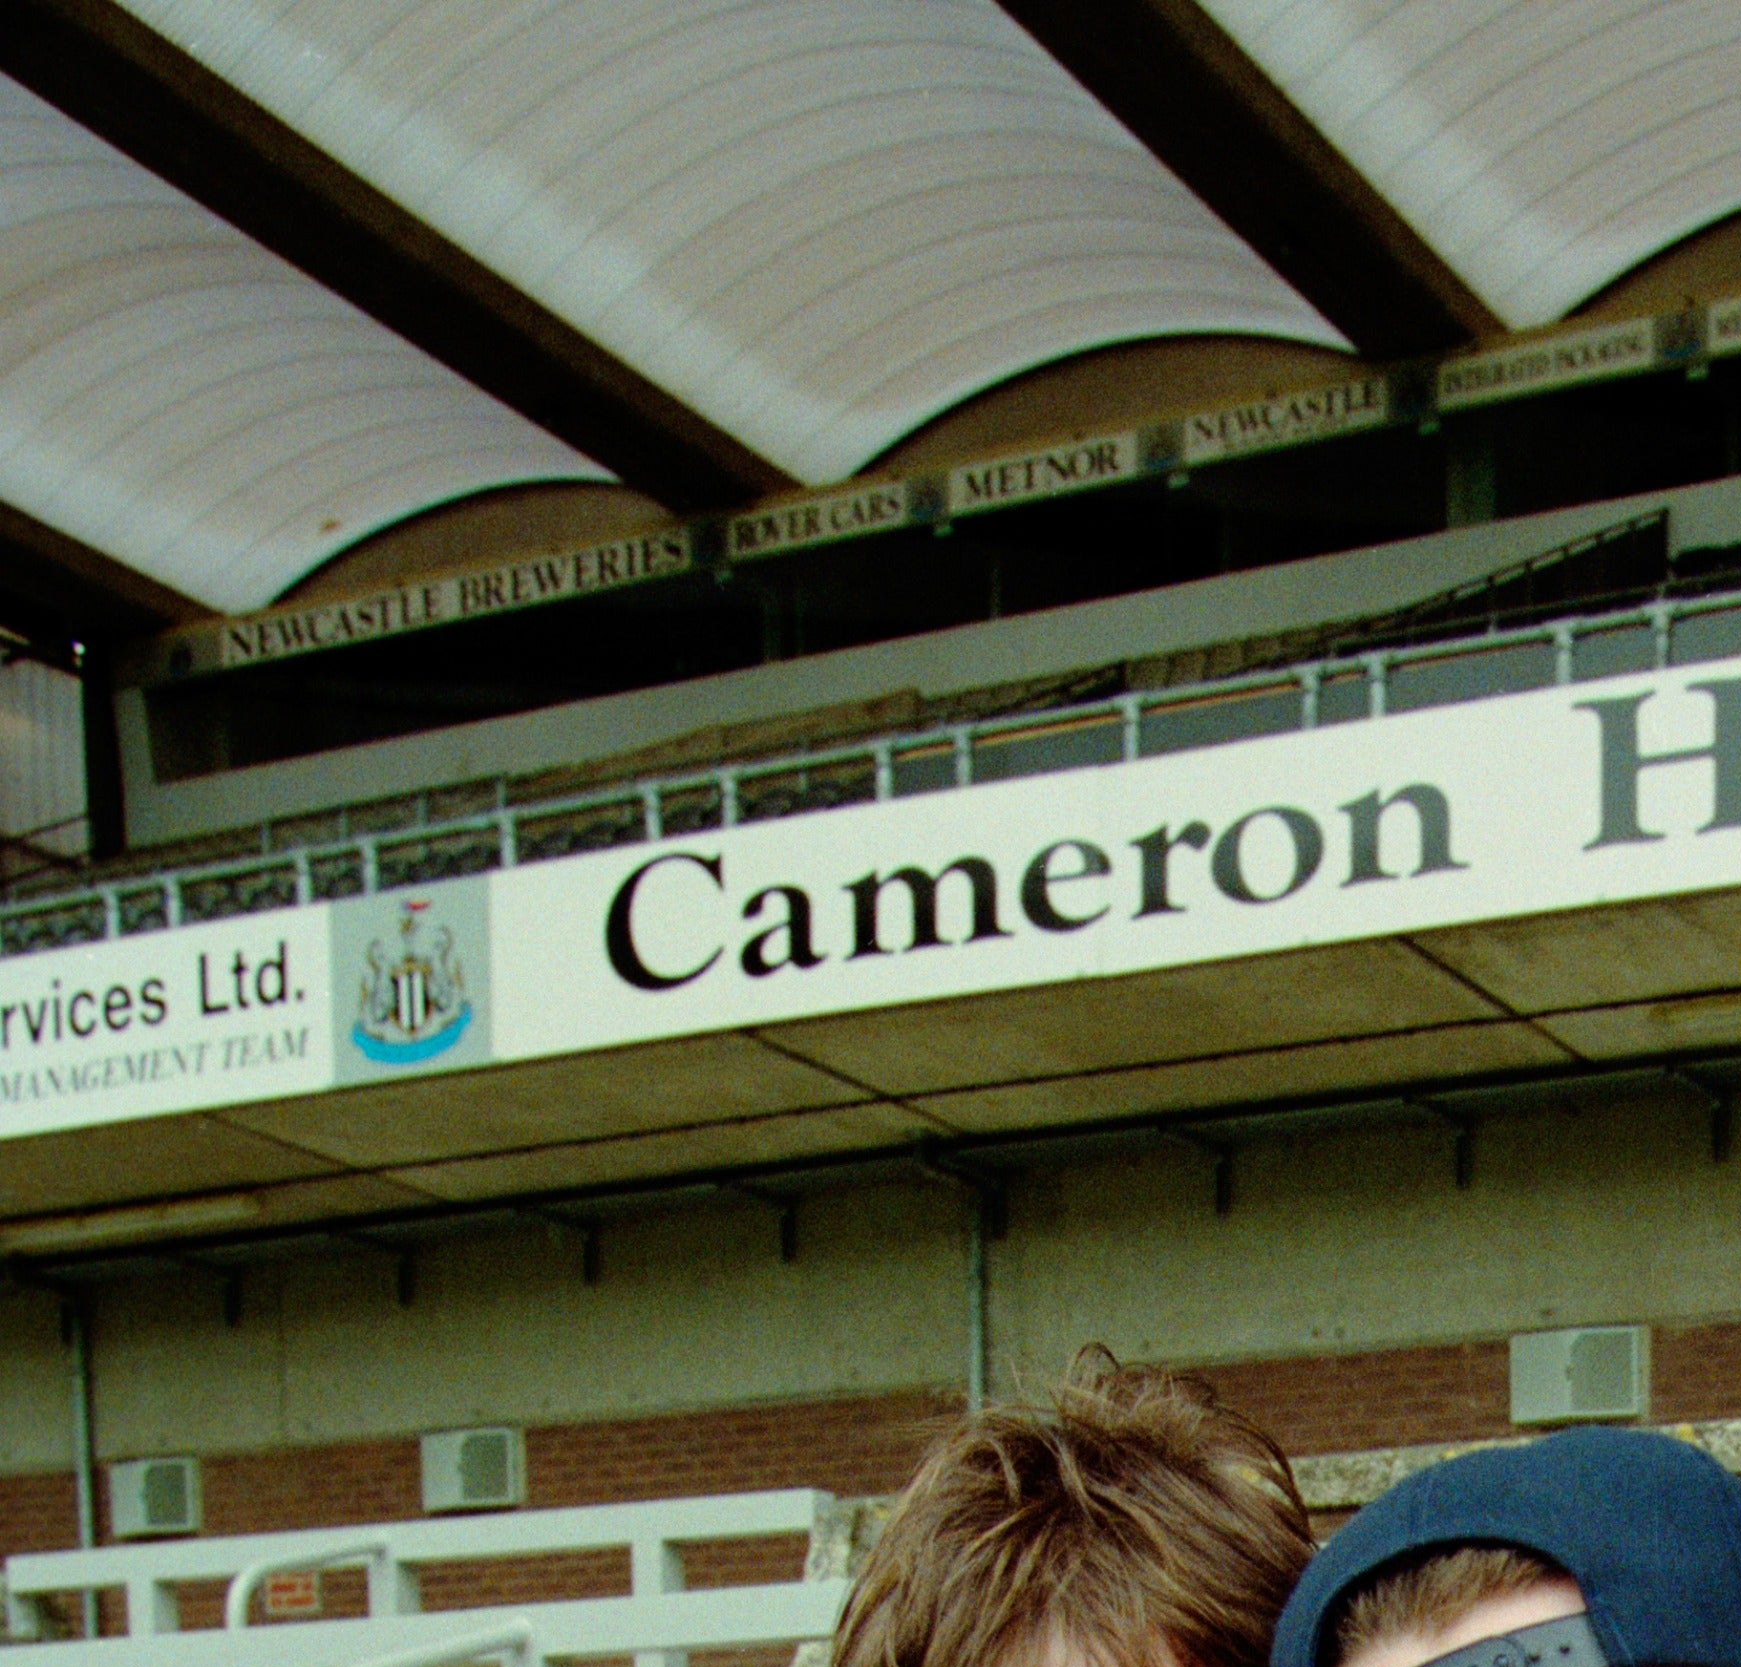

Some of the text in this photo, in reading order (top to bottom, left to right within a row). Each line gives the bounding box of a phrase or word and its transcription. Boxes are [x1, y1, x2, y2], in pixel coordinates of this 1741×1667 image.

[1193, 379, 1384, 441] NEWCASTLE
[963, 443, 1119, 500] METNOR
[735, 490, 901, 548] ROVER CARS
[227, 538, 685, 662] NEWCASTLE BREWERIES
[605, 782, 1469, 993] Cameron
[0, 941, 304, 1048] rvices Ltd.
[221, 1028, 310, 1072] TEAM
